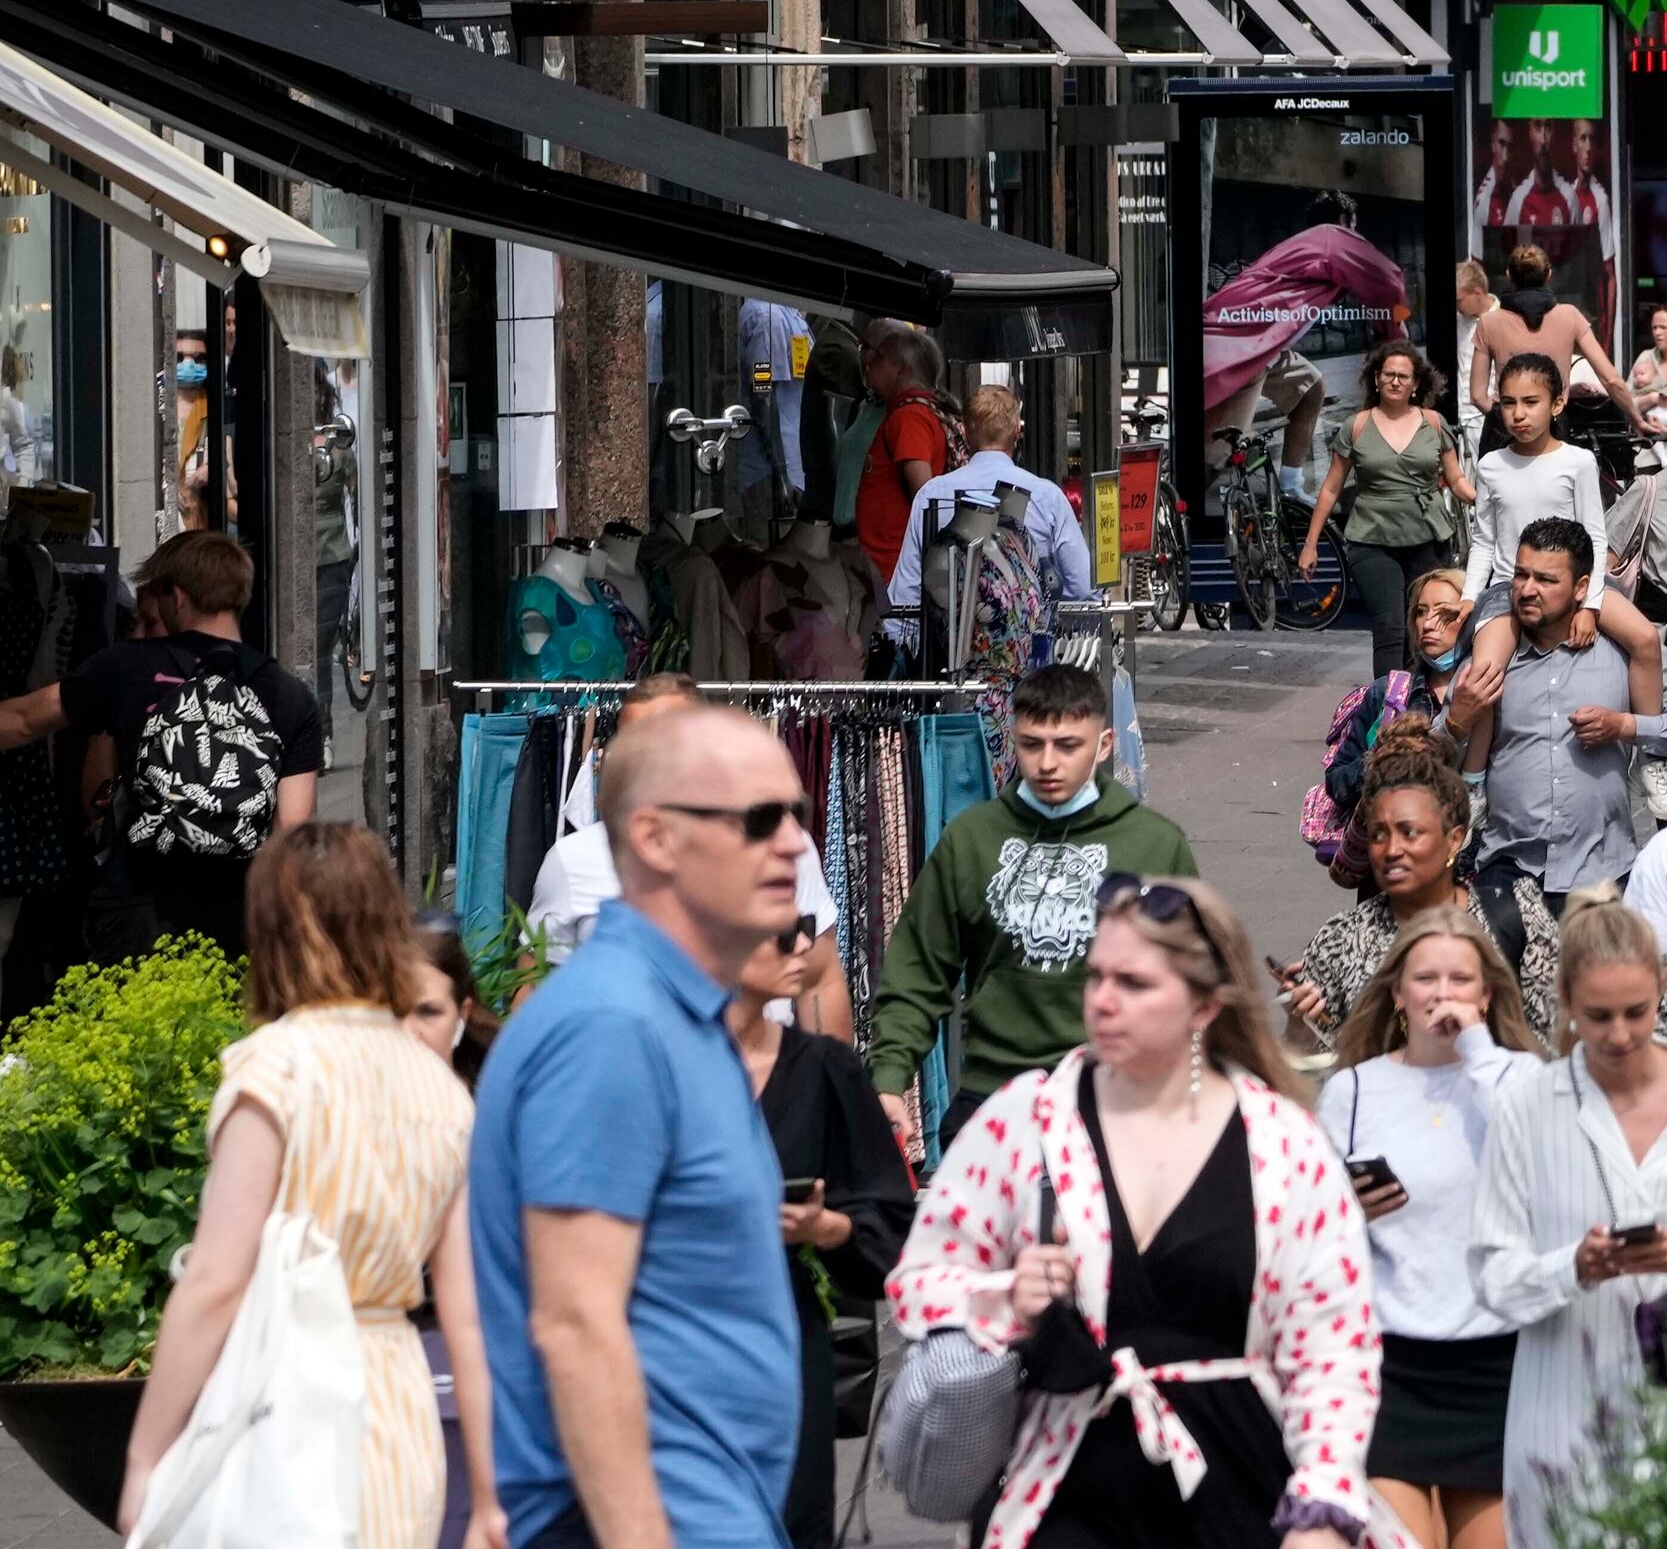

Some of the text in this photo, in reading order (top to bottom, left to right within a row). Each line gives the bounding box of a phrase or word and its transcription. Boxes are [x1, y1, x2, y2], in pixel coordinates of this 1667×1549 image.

[1502, 65, 1586, 92] unisport
[1274, 97, 1350, 110] AFA JCDecaux
[1339, 128, 1410, 146] zalando
[1217, 303, 1391, 325] ActivistsofOptimism
[1130, 493, 1148, 510] 129
